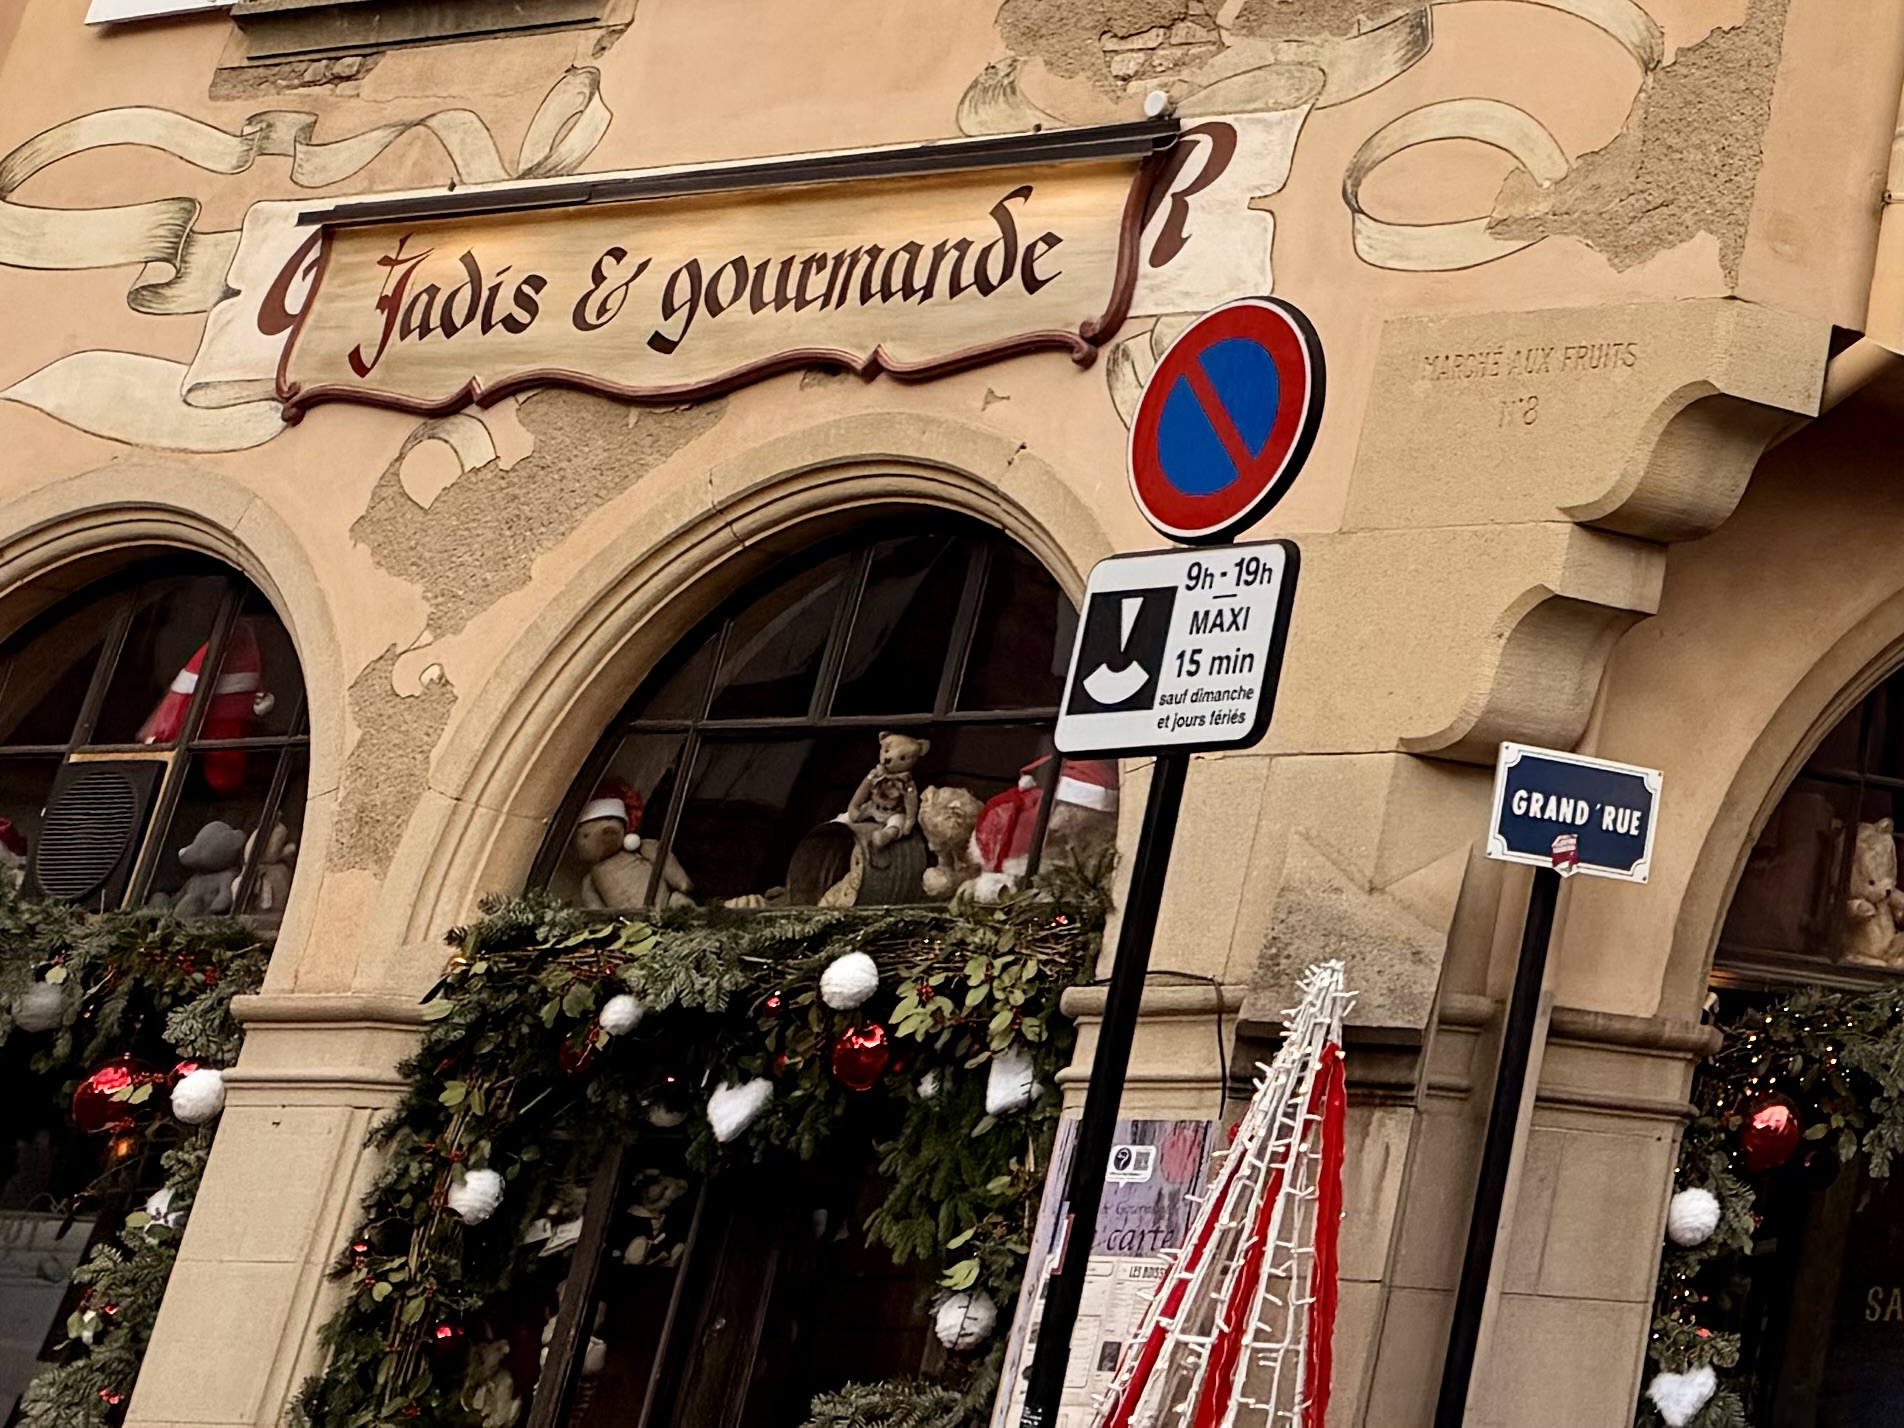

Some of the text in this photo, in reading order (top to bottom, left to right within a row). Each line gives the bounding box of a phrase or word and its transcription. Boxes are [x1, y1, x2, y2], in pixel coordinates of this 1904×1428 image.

[347, 232, 548, 378] Jadis
[571, 245, 653, 332] &
[646, 184, 1064, 355] gourmande
[1507, 346, 1554, 375] AUX
[1560, 342, 1639, 372] FRUITS
[1188, 606, 1251, 635] MAXI
[1175, 647, 1255, 678] 15 min
[1158, 685, 1254, 706] sauf dimanche
[1157, 708, 1247, 732] et jours fériés
[1511, 788, 1590, 826] GRAND
[1106, 1224, 1175, 1252] carte
